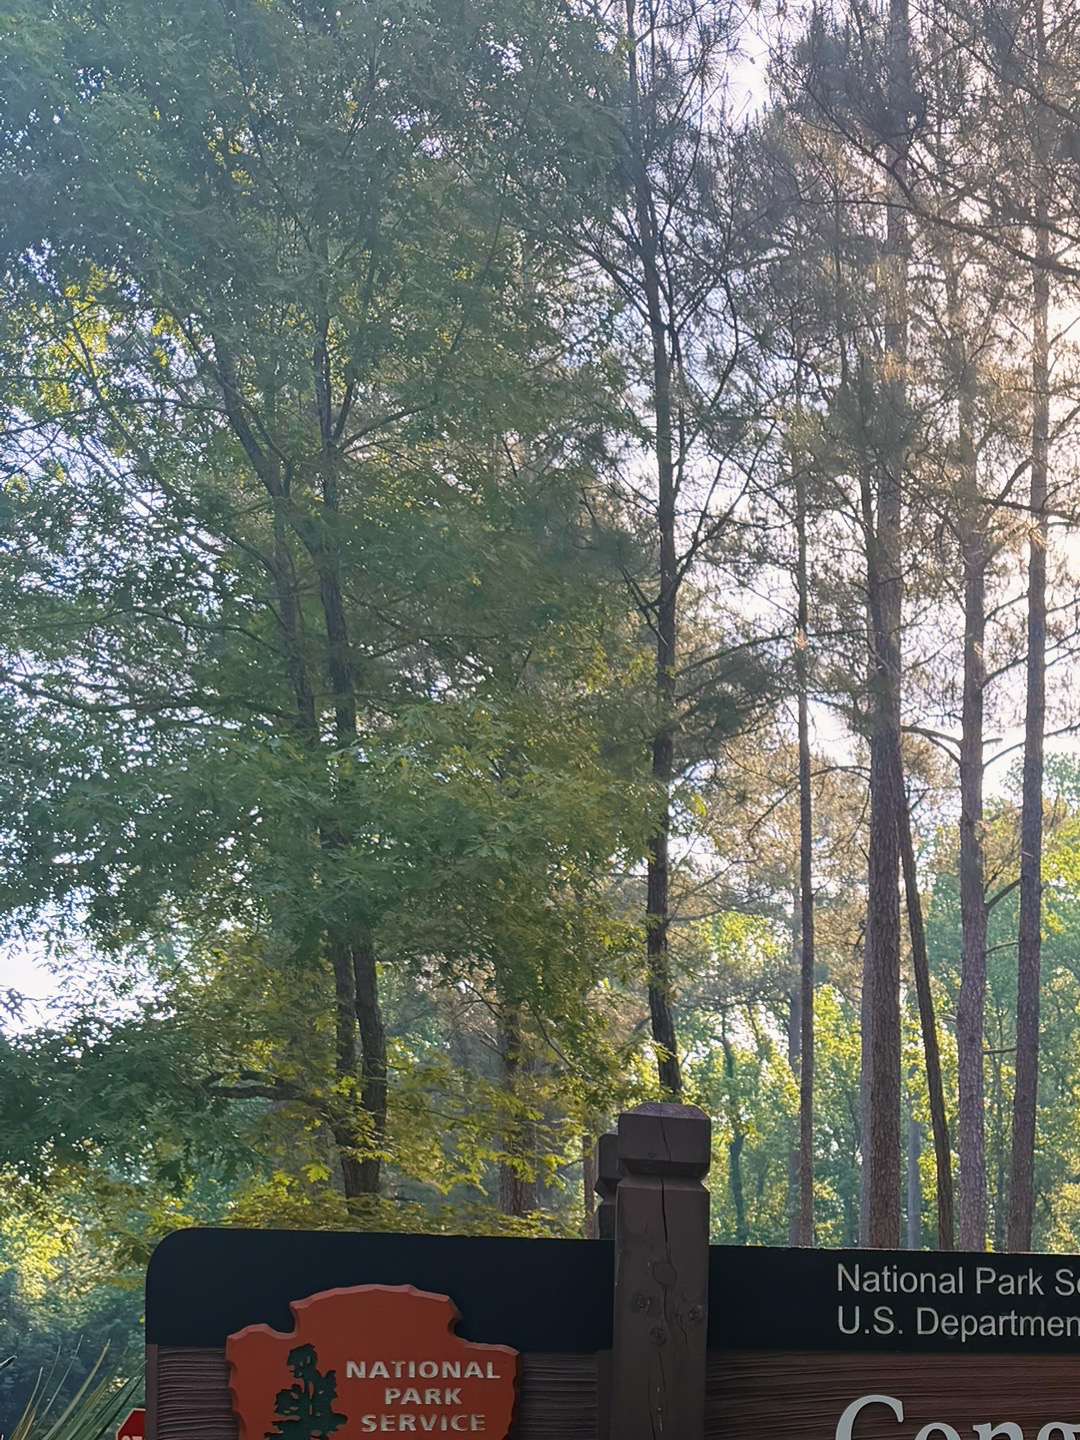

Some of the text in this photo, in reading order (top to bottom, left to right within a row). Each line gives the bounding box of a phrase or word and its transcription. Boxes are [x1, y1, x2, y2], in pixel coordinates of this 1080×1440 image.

[837, 1264, 964, 1294] National
[976, 1267, 1044, 1296] Park
[838, 1306, 903, 1335] U.S.
[346, 1361, 501, 1378] NATIONAL
[385, 1388, 462, 1404] PARK
[361, 1414, 486, 1432] SERVICE
